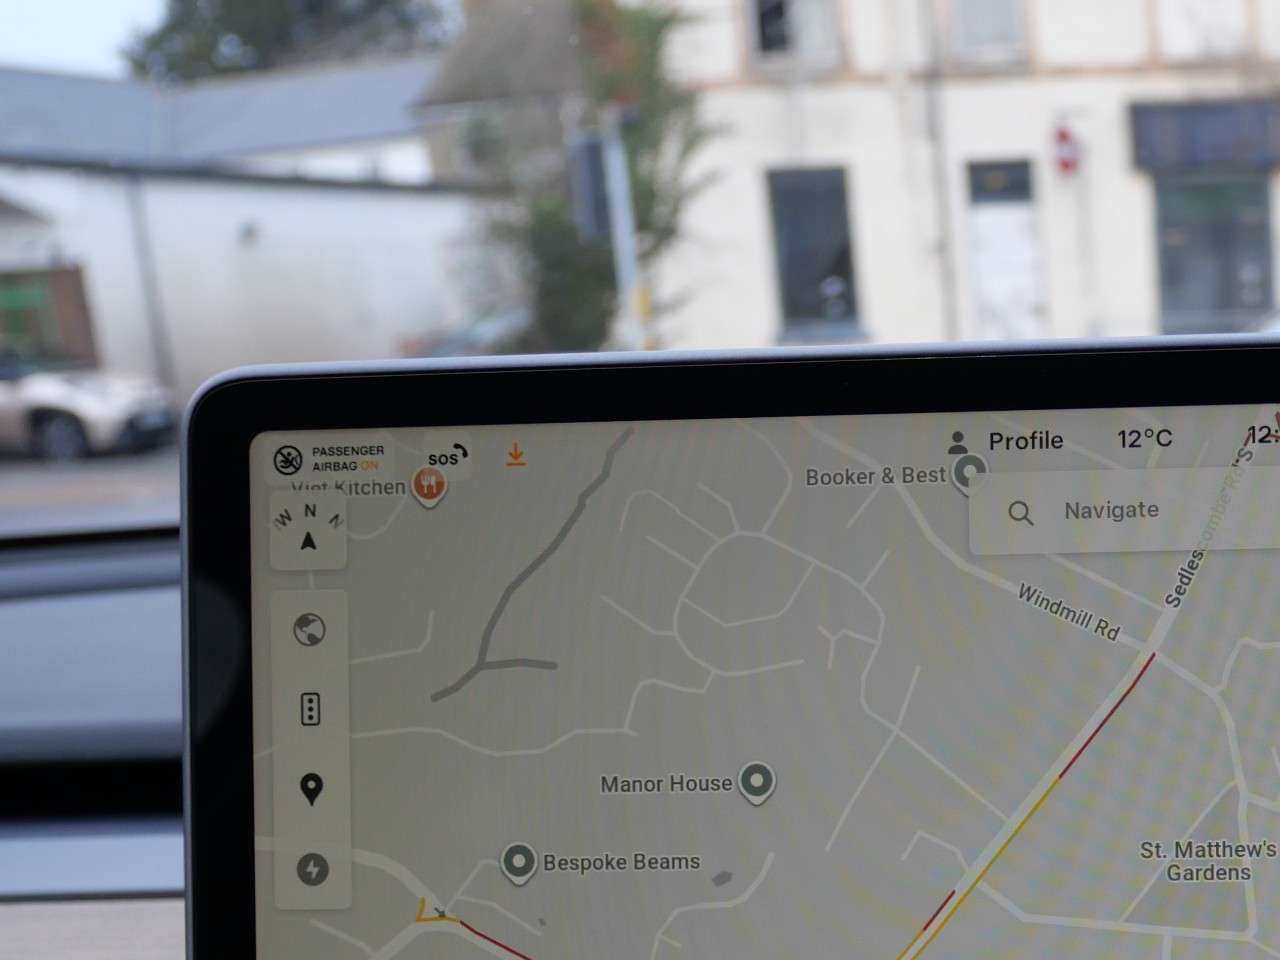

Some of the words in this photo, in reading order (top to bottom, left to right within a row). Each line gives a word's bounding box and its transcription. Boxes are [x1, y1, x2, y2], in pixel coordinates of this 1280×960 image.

[989, 430, 1064, 451] Profile
[1117, 428, 1174, 449] 12°C
[312, 445, 385, 457] PASSENGER
[428, 453, 459, 467] SOS
[312, 461, 358, 473] AIRBAG
[361, 460, 379, 472] ON
[805, 468, 875, 487] Booker
[881, 467, 895, 485] &
[902, 465, 946, 484] Best
[304, 503, 317, 518] N
[1065, 501, 1160, 523] Navigate
[1017, 582, 1093, 631] Windmill
[1095, 615, 1121, 642] Rd
[601, 776, 664, 793] Manor
[670, 774, 733, 792] House
[1140, 841, 1168, 860] St.
[1174, 840, 1277, 859] Matthew's
[543, 853, 628, 876] Bespoke
[634, 853, 701, 871] Beams
[1167, 863, 1252, 882] Gardens
